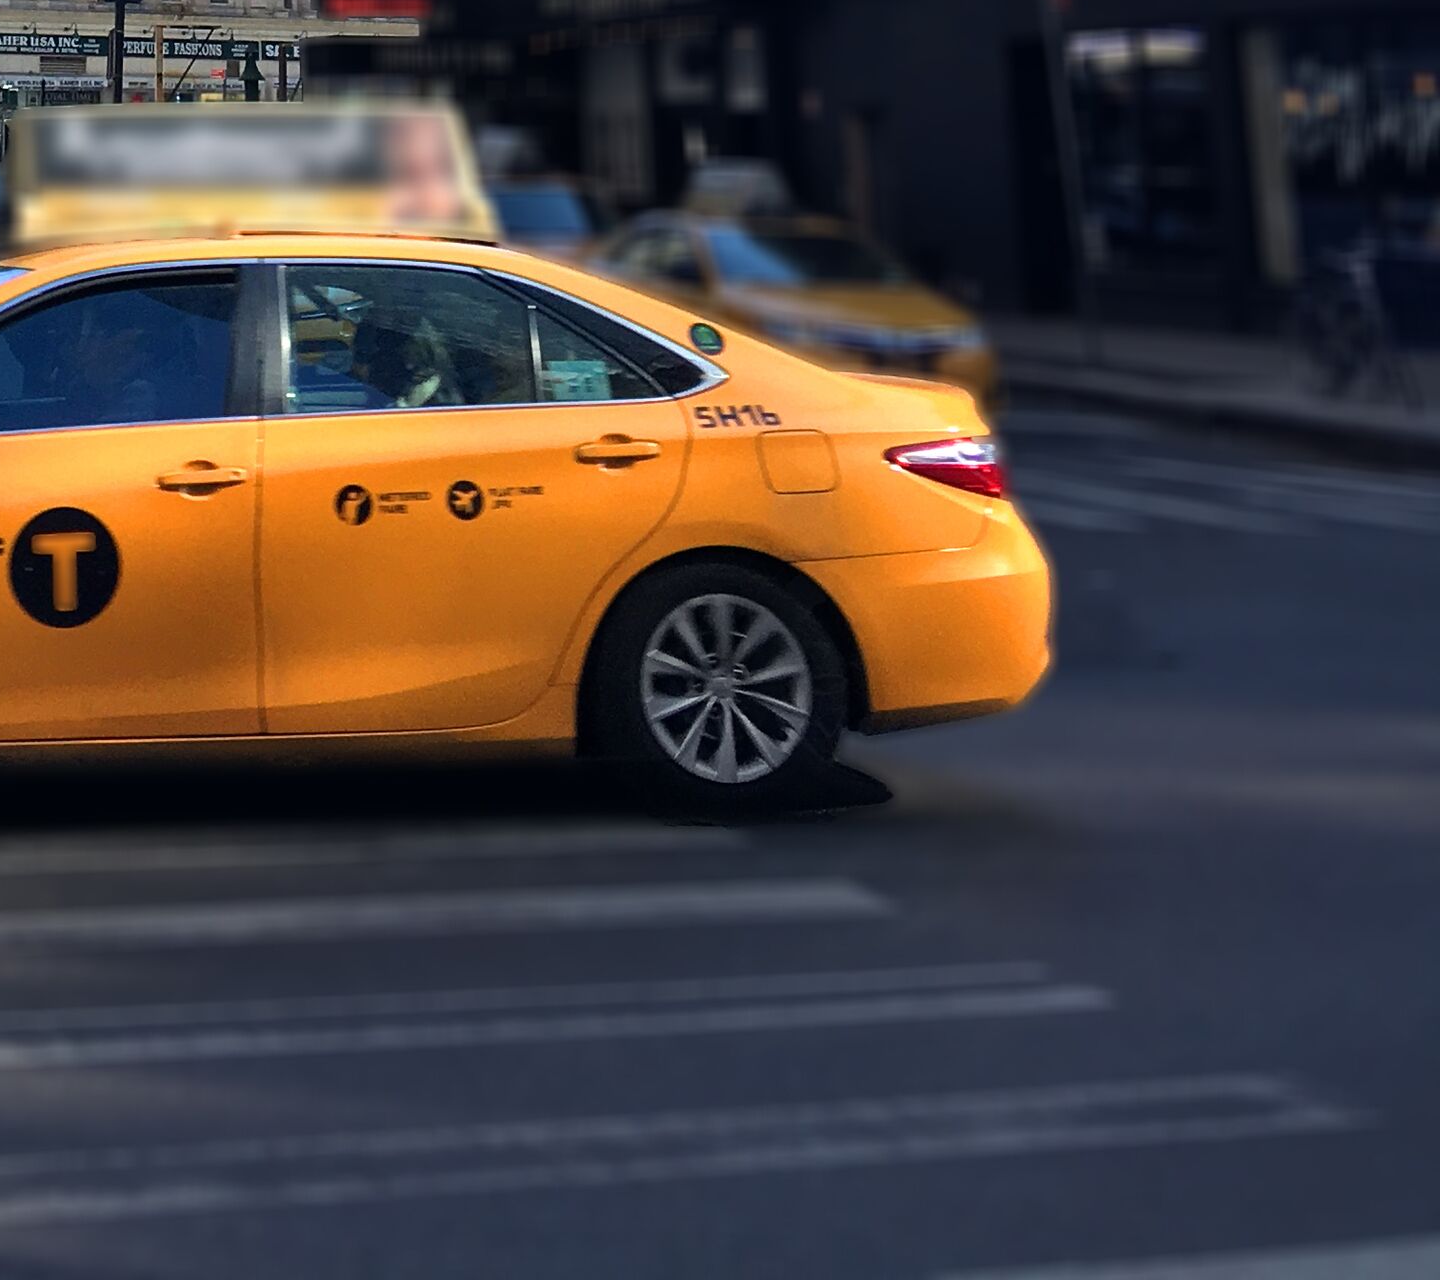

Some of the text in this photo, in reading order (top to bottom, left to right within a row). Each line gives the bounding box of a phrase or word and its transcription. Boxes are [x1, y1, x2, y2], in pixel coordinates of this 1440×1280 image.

[31, 36, 56, 48] USA
[58, 37, 82, 48] INC.
[123, 41, 169, 55] ERFUE
[31, 531, 97, 612] T
